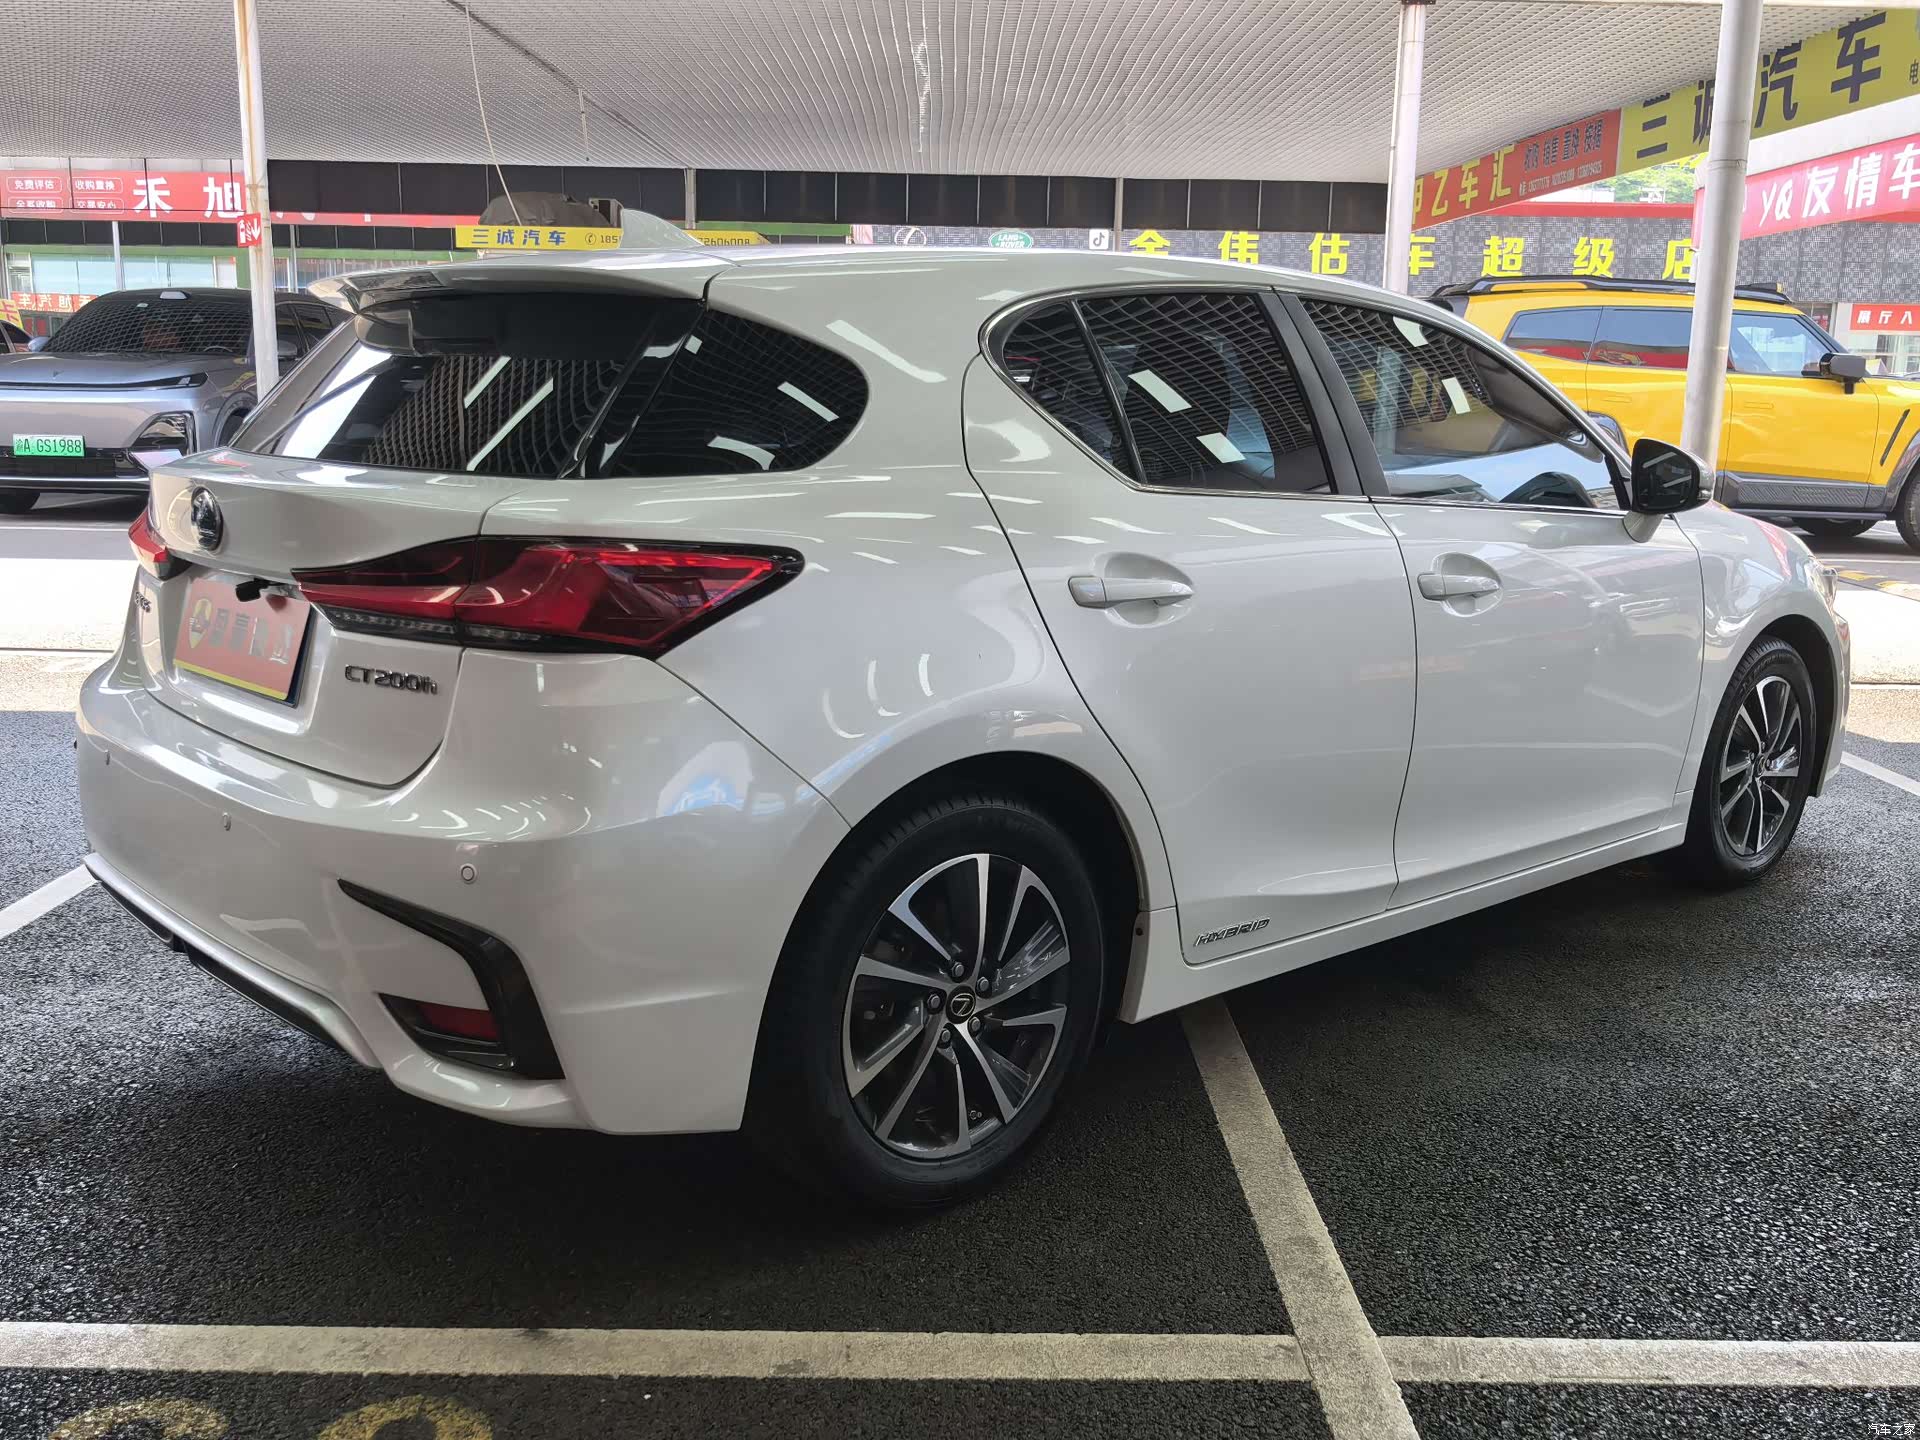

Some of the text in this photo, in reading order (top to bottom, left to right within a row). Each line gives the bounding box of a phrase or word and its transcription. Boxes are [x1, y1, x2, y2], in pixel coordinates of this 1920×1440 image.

[132, 176, 245, 219] 禾旭
[472, 229, 566, 246] 三诚汽车
[1193, 917, 1270, 947] HYBRID
